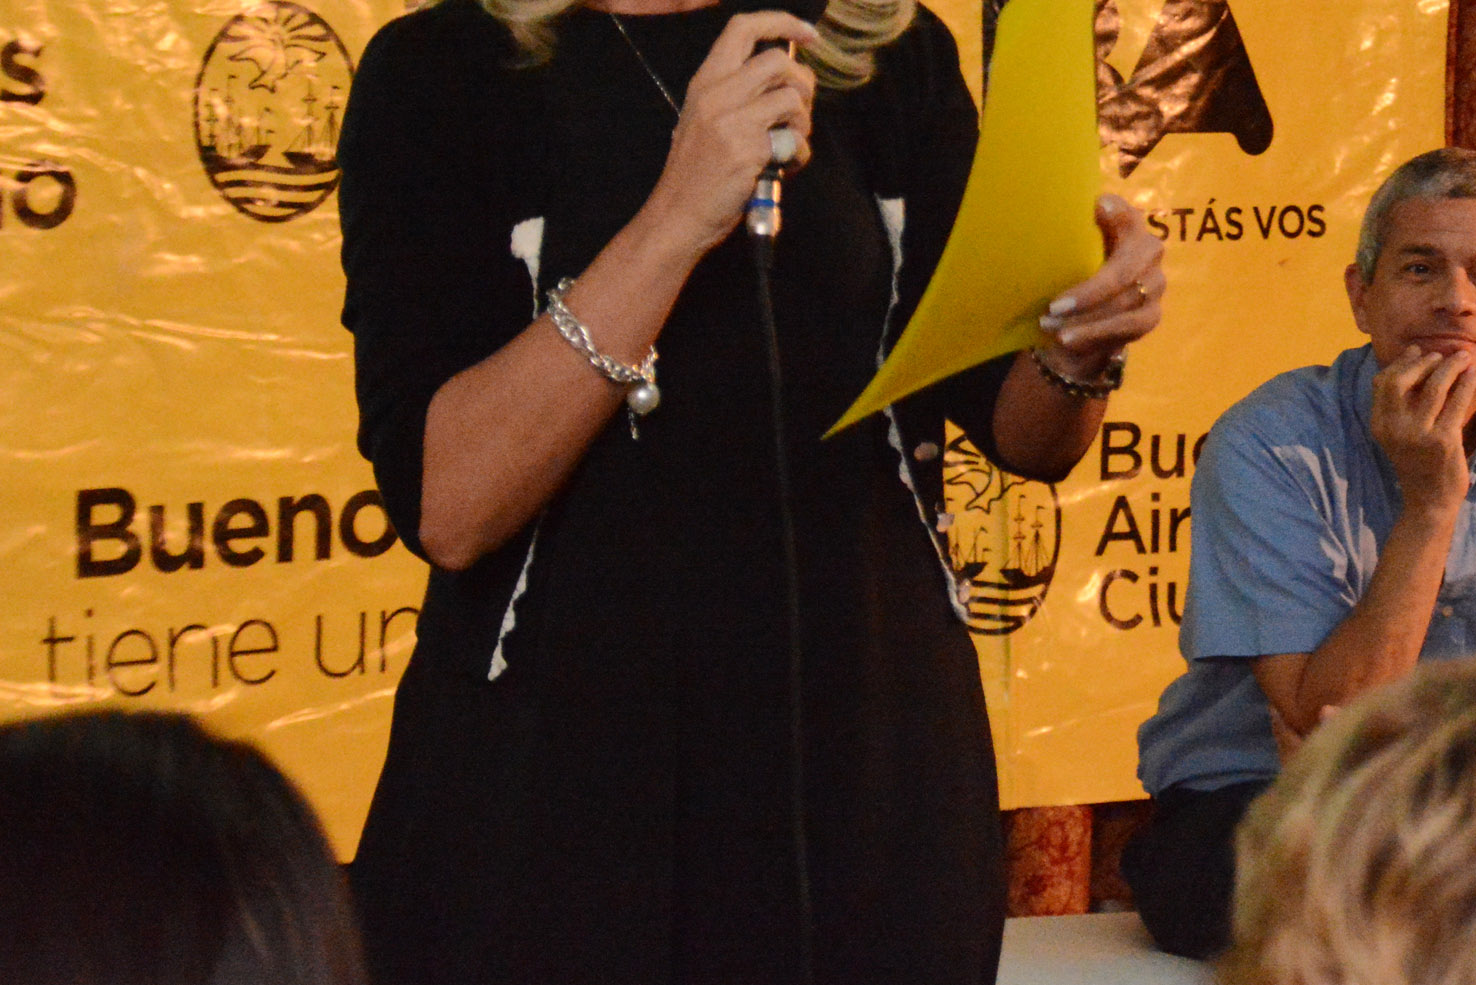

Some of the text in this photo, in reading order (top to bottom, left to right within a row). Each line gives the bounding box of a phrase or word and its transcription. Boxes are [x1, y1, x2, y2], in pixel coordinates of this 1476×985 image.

[1147, 198, 1327, 242] STÁS VOS
[75, 486, 398, 579] Bueno
[1095, 492, 1191, 556] Air
[43, 608, 279, 697] tiene
